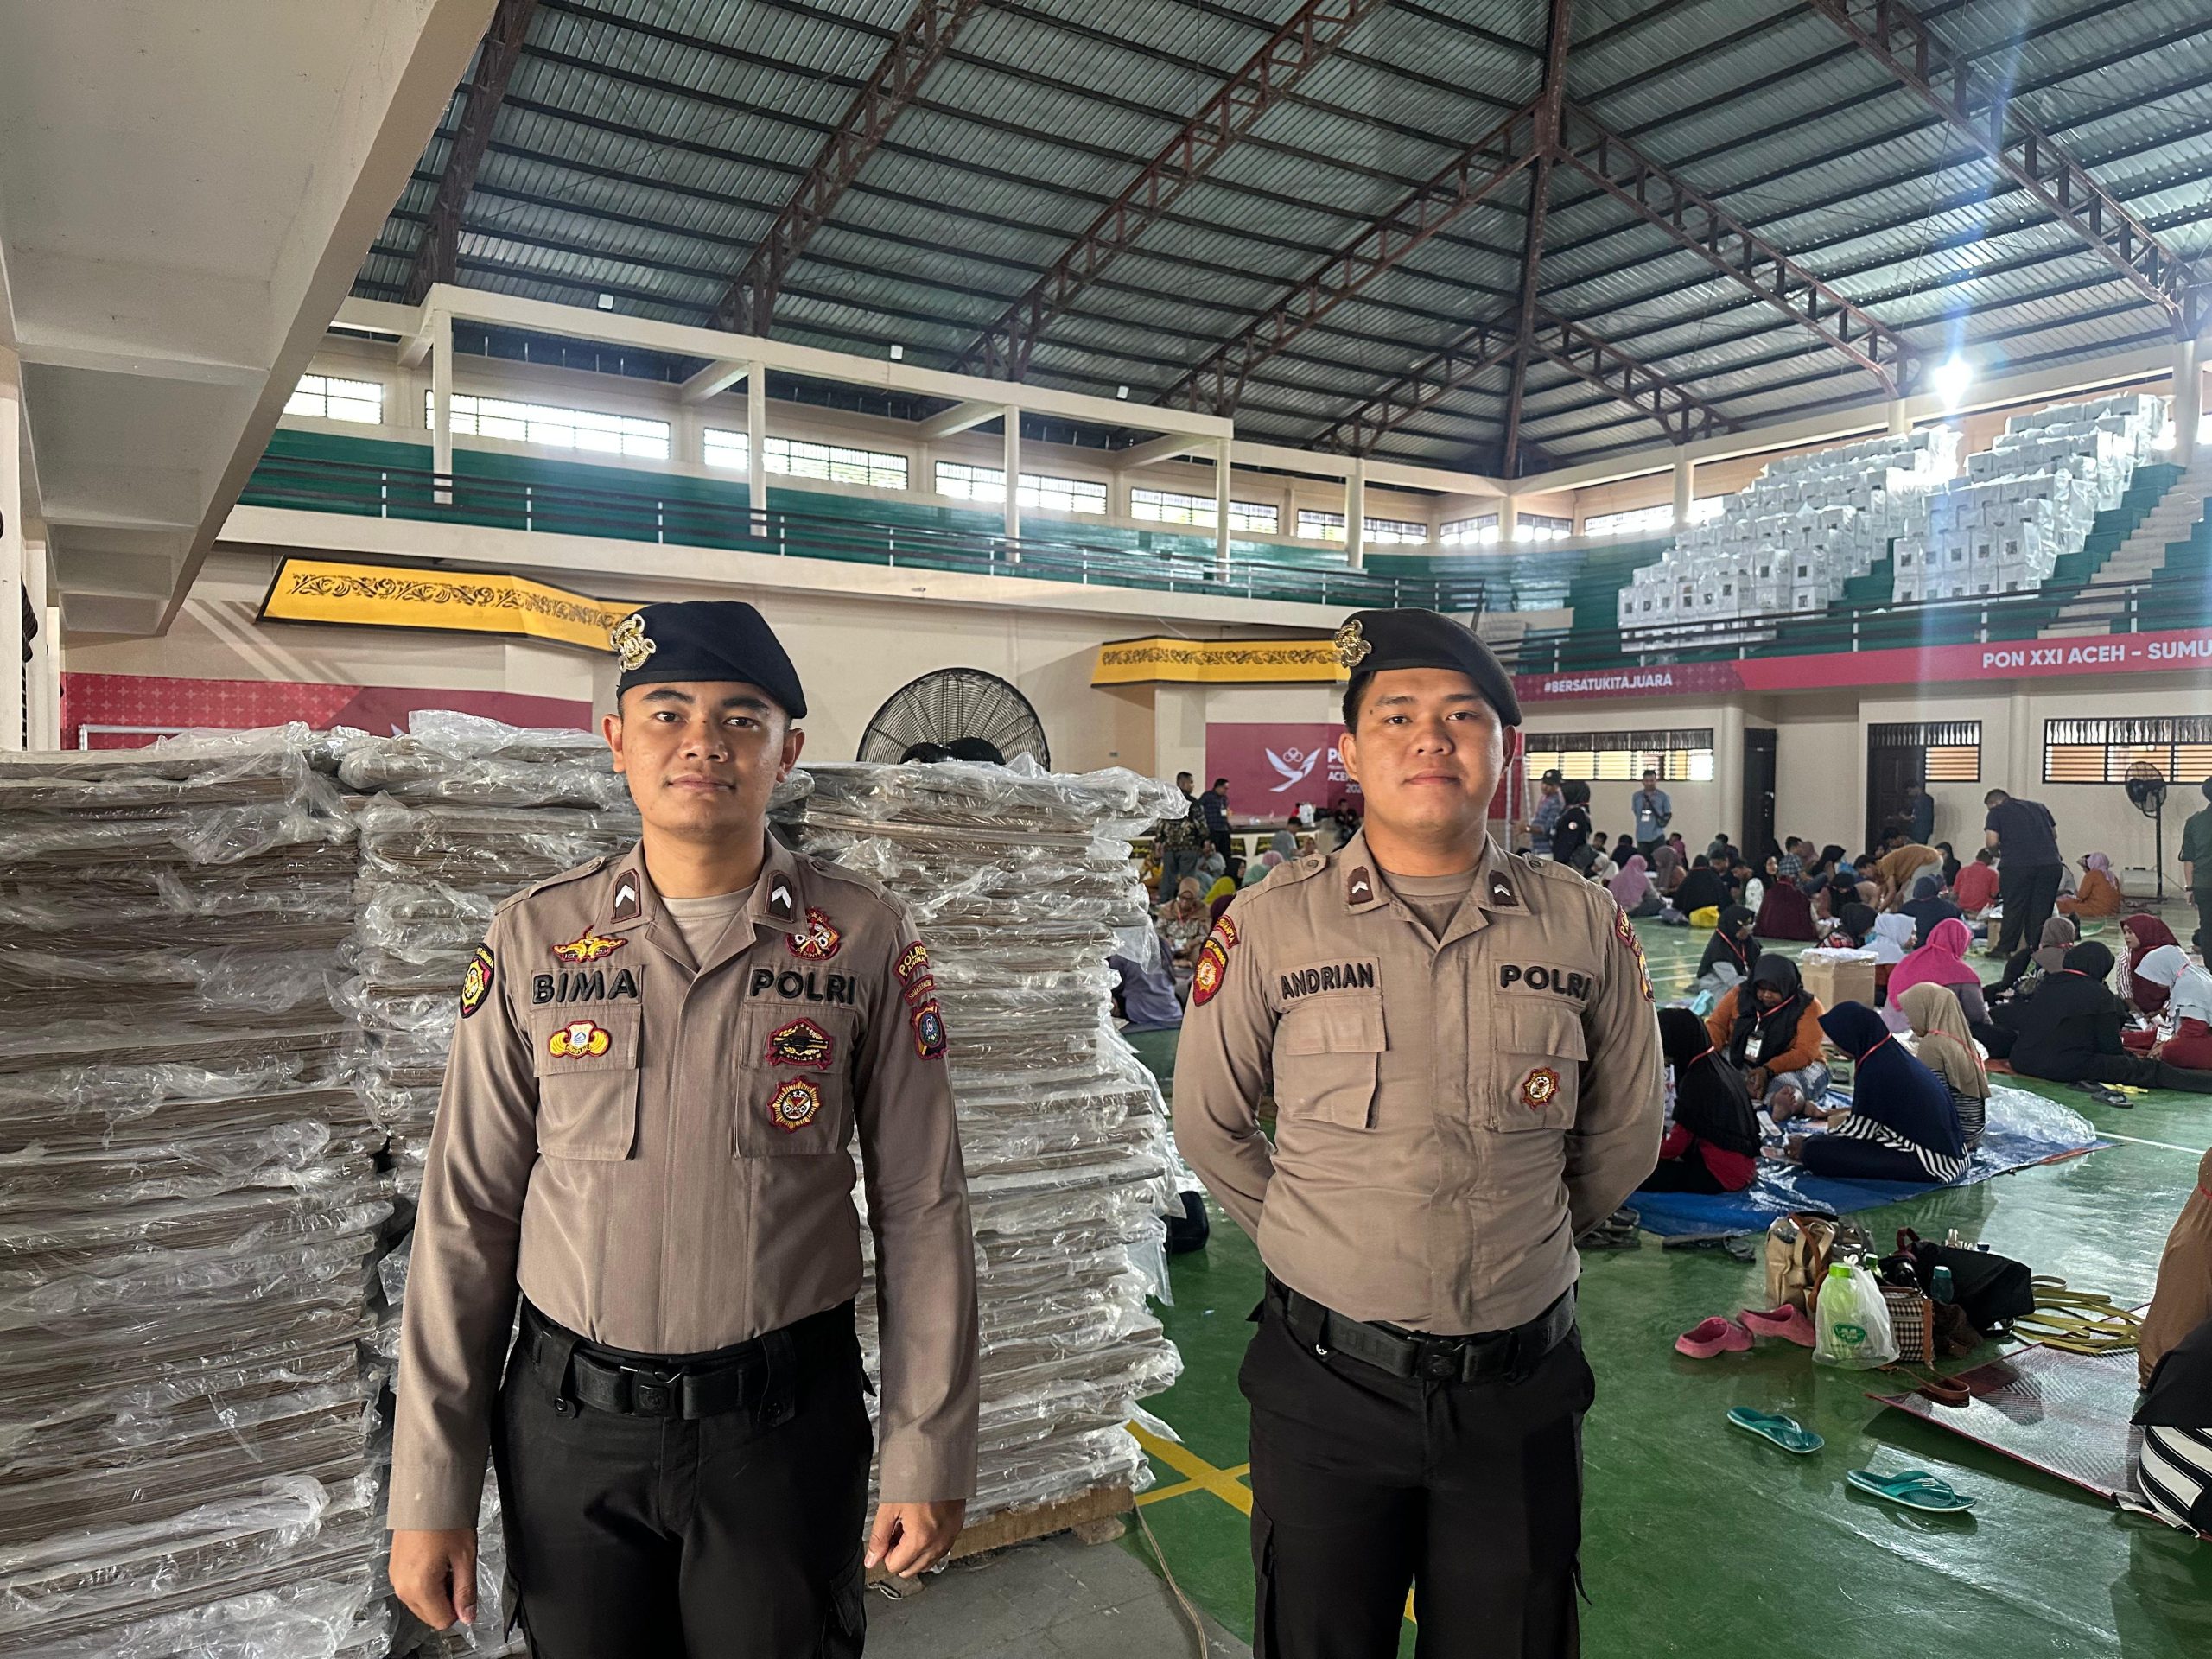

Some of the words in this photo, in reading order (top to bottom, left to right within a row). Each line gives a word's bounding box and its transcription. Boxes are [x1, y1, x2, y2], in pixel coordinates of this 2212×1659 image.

[1982, 650, 2024, 669] PON
[2029, 648, 2063, 666] XXI
[2067, 645, 2126, 664] ACEH
[2147, 639, 2212, 660] SUMU
[1543, 672, 1673, 693] #BERSATUKITAJUARA
[1327, 771, 1350, 781] ACE
[898, 945, 928, 976] POLRE
[532, 969, 639, 1004] BIMA
[749, 969, 856, 1005] POLRI
[1281, 963, 1375, 1001] ANDRIAN
[1499, 964, 1592, 1001] POLRI
